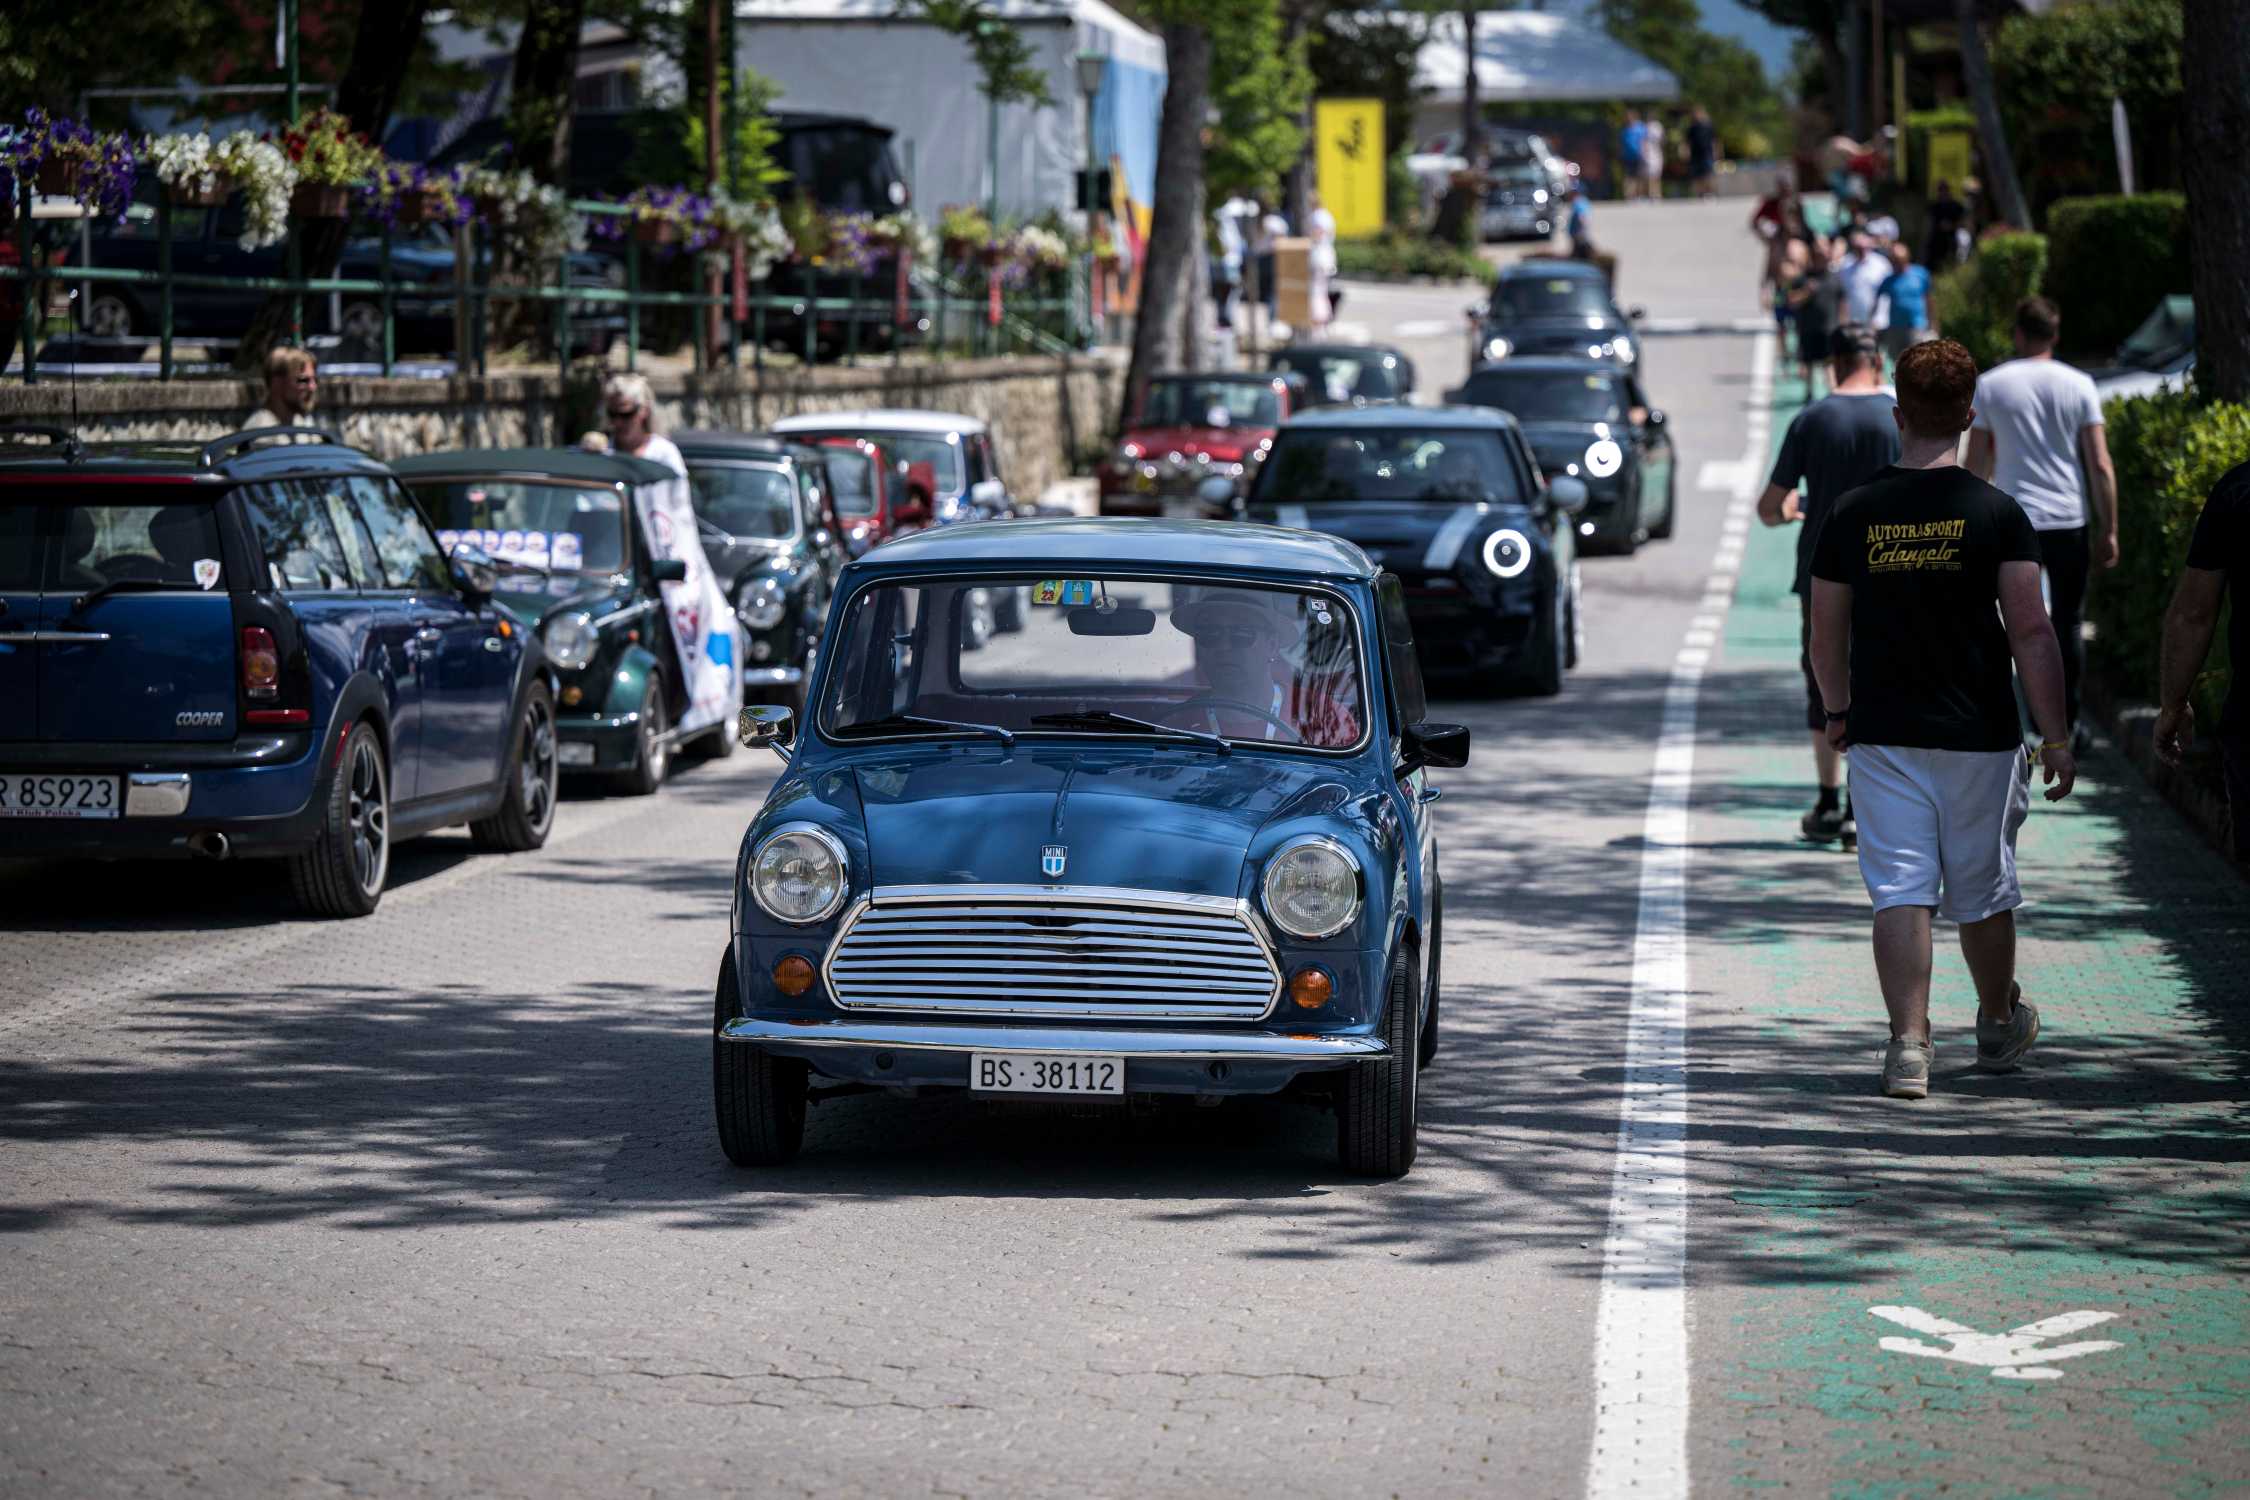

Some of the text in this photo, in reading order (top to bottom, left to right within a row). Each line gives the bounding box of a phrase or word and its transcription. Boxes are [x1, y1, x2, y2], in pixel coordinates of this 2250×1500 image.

[1867, 519, 1964, 543] AUTOTRASPORTI
[1868, 540, 1959, 567] Colangelo
[1041, 591, 1055, 601] 23
[176, 711, 224, 725] COOPER
[19, 777, 112, 808] 8S923
[1045, 847, 1064, 857] MINI
